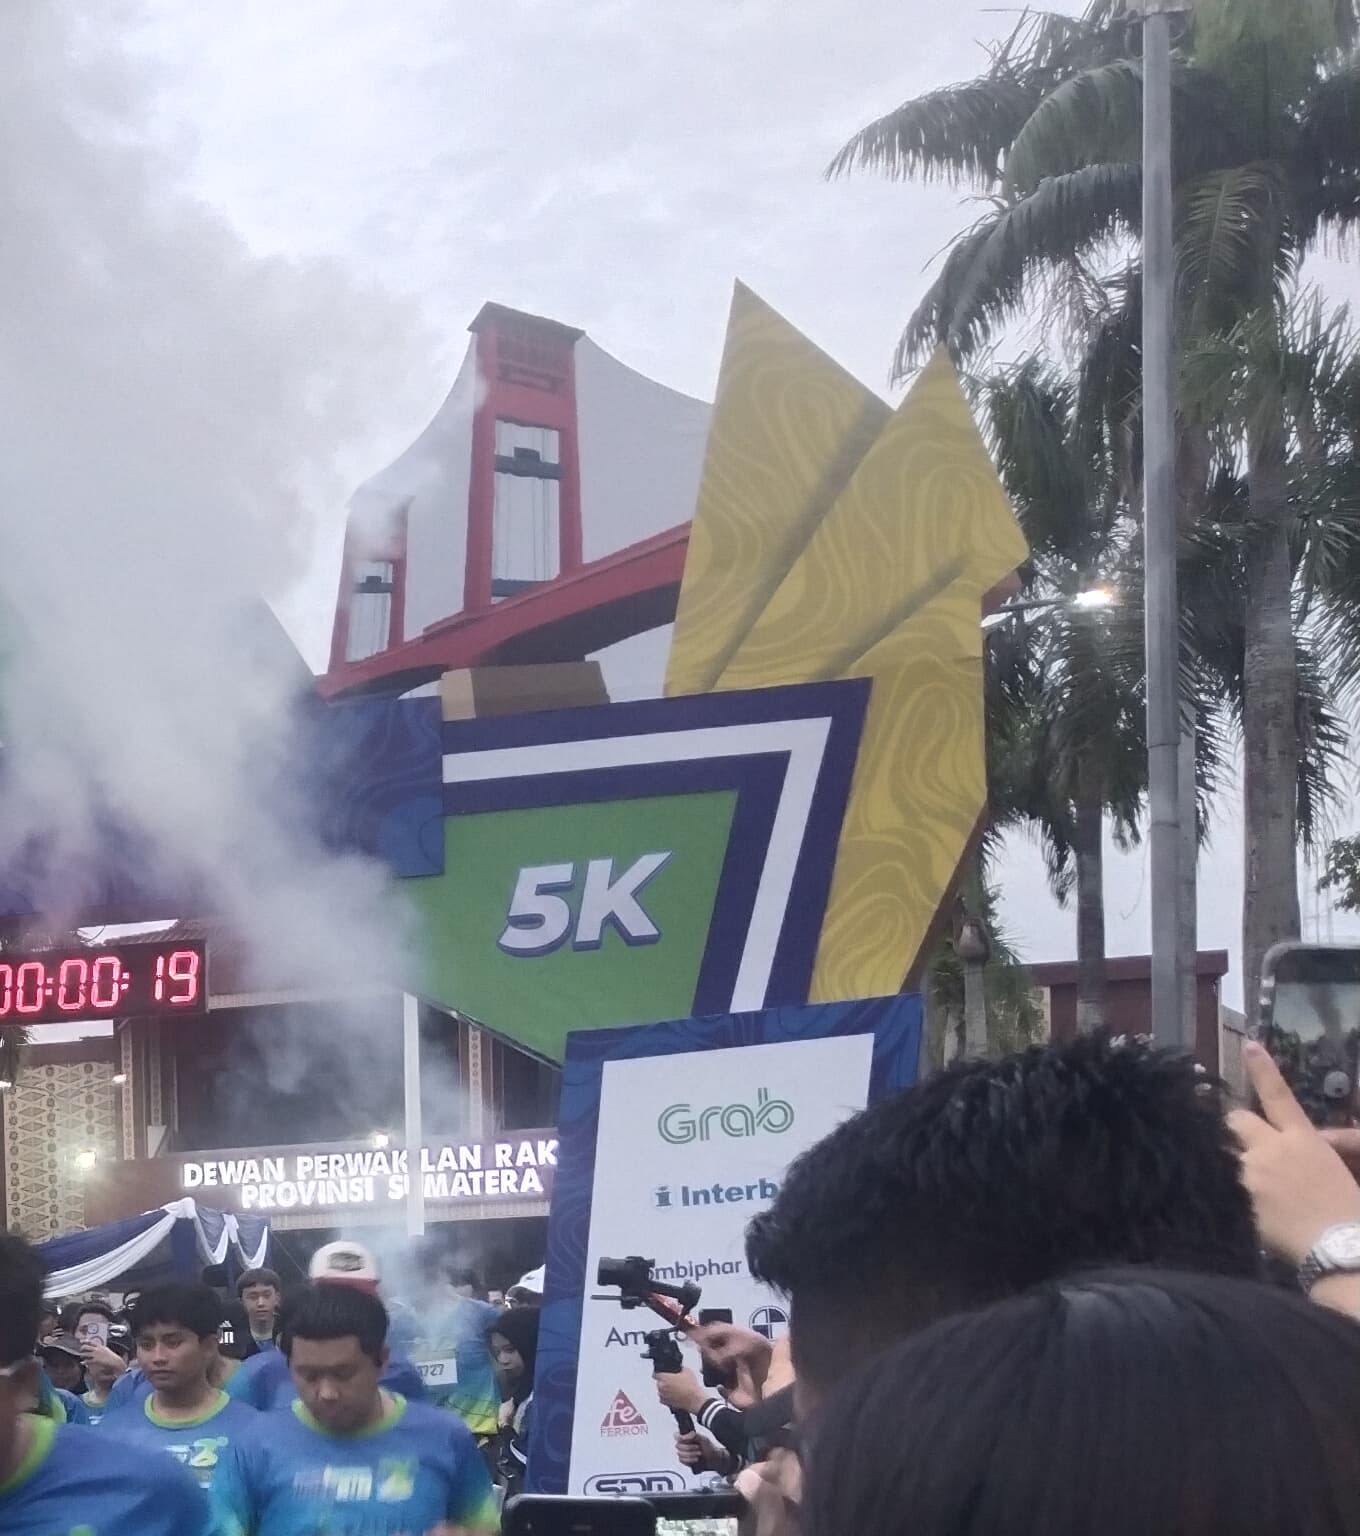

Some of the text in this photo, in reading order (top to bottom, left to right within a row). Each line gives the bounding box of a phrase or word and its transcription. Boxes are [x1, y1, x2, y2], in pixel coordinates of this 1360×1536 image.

[496, 850, 673, 957] 5K
[657, 1087, 795, 1145] Grab
[183, 1139, 560, 1188] DEWAN PERWAKLAN RAK
[241, 1174, 374, 1209] PROVINSI
[681, 1178, 779, 1207] Interb
[647, 1258, 743, 1282] mbiphar
[600, 1424, 649, 1438] FERRON
